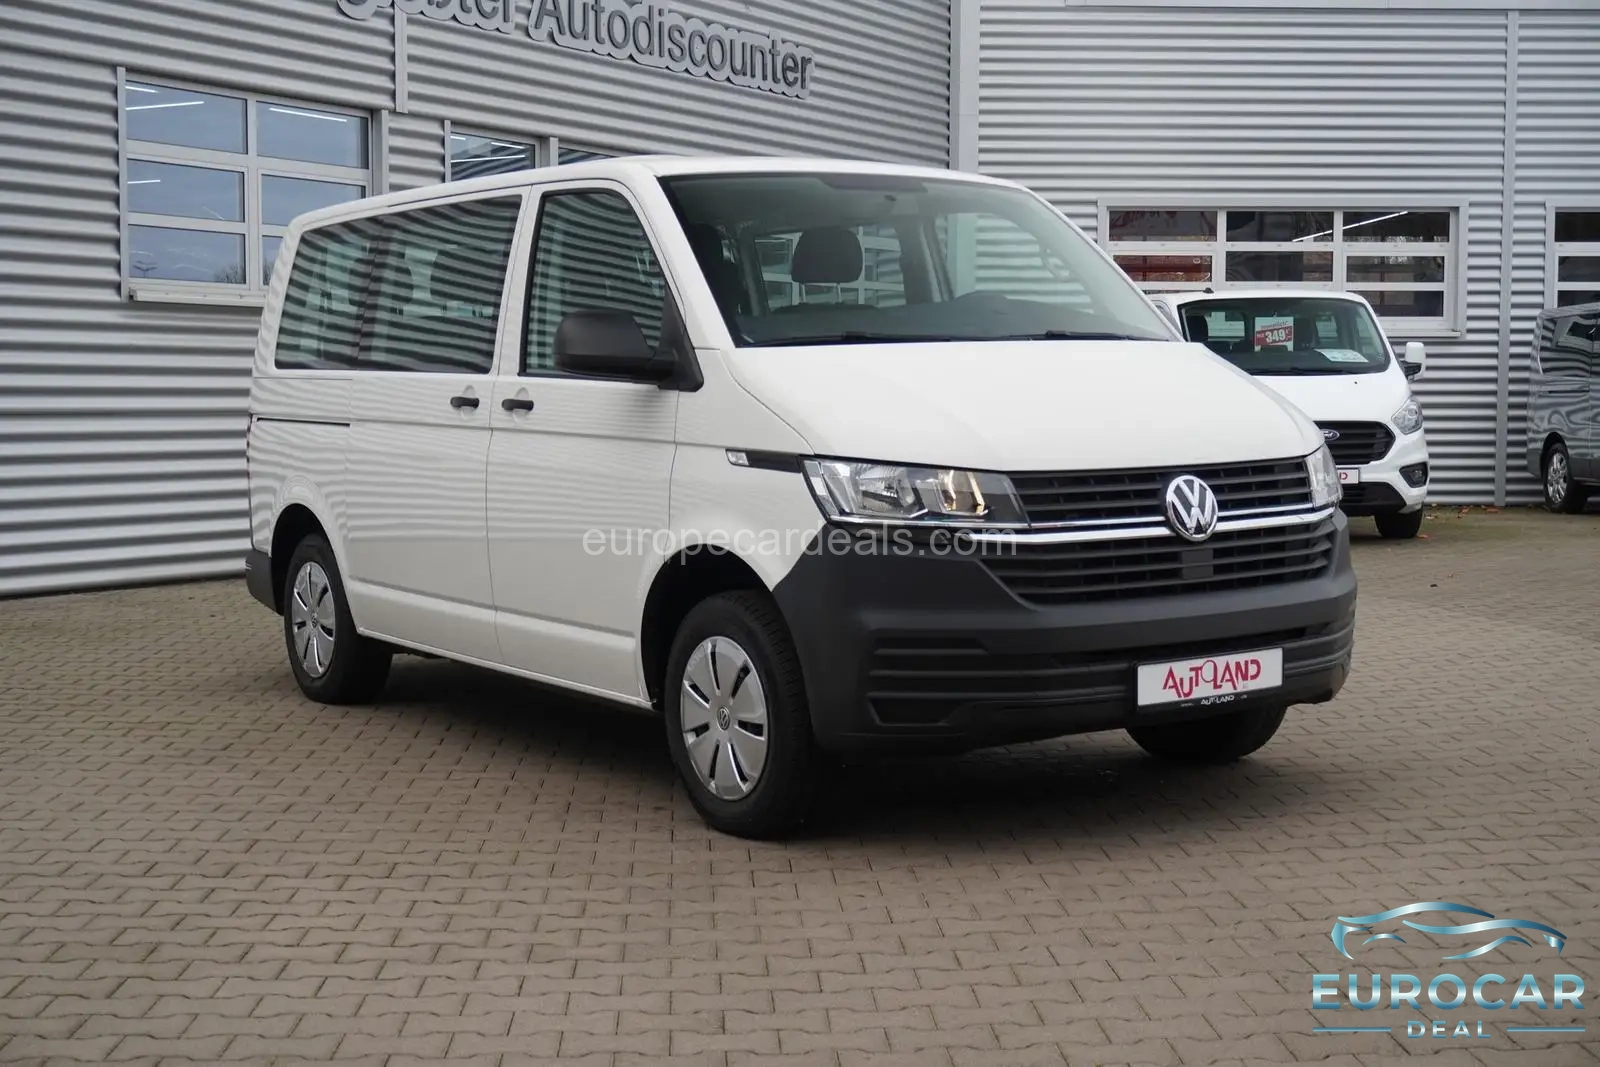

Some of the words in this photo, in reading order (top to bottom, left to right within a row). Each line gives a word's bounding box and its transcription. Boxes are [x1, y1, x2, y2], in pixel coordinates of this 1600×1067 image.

[534, 0, 812, 90] Autodiscounter
[1265, 329, 1286, 343] 349
[1166, 475, 1218, 541] VW
[1162, 659, 1262, 698] AUTOLAND
